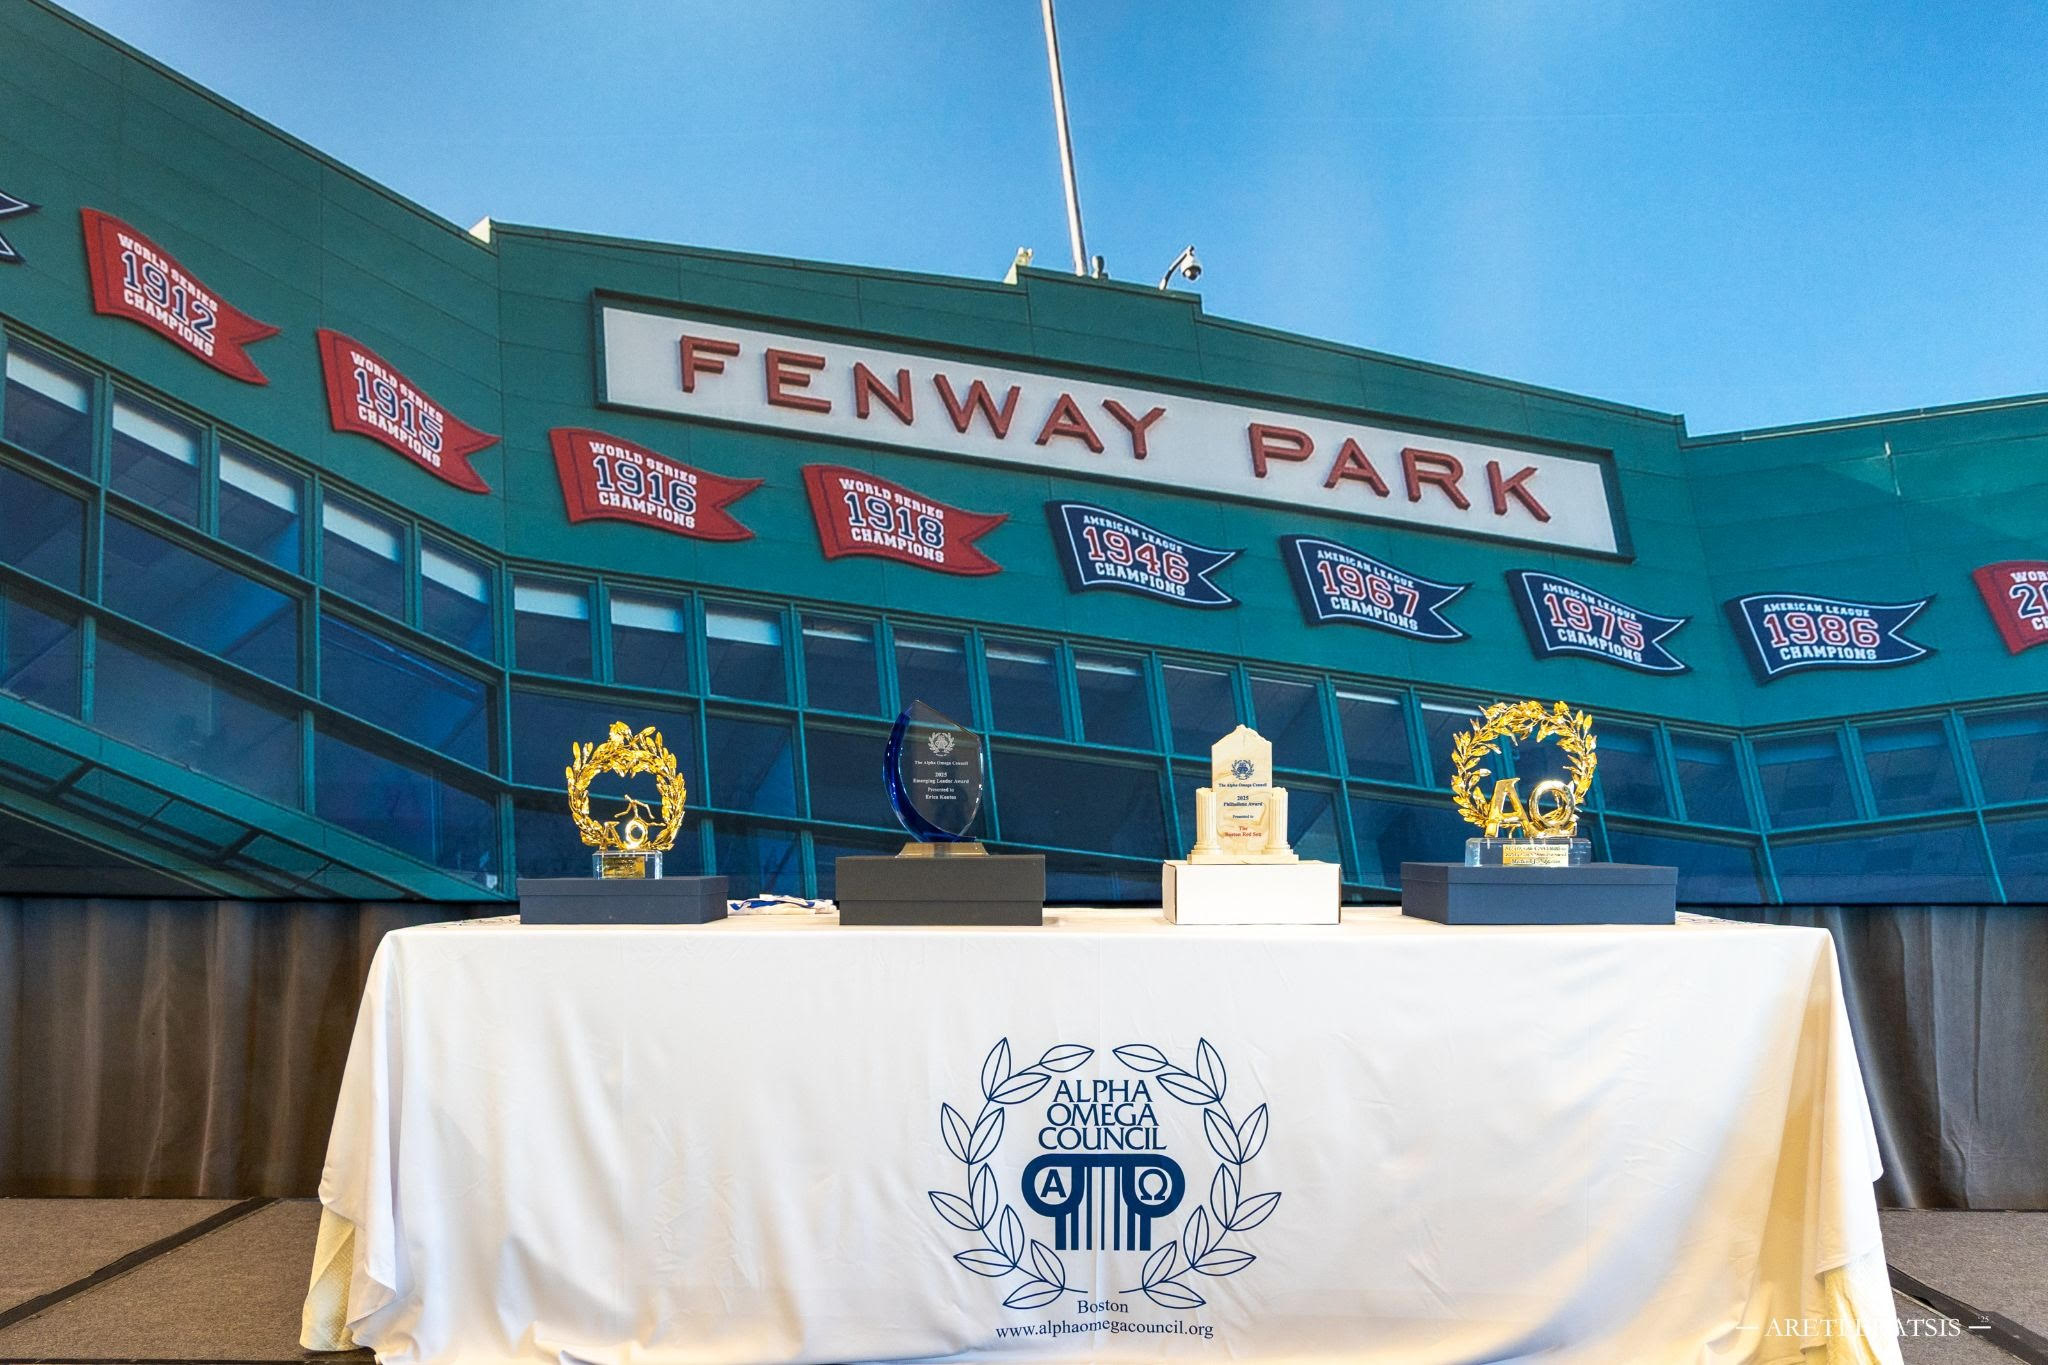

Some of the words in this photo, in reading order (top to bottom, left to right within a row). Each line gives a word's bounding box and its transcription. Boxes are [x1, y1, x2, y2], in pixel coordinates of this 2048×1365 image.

[117, 232, 169, 274] WORLD
[171, 268, 218, 312] SERIES
[121, 250, 216, 344] 1912
[124, 288, 213, 357] CHAMPIONS
[350, 351, 398, 389] WORLD
[399, 383, 443, 424] SERIES
[354, 367, 443, 453] 1915
[680, 335, 1166, 460] FENWAY
[1248, 422, 1551, 523] PARK
[358, 405, 441, 468] CHAMPIONS
[588, 441, 643, 465] WORLD
[646, 457, 697, 485] SERIES
[593, 455, 696, 515] 1916
[839, 478, 892, 500] WORLD
[894, 493, 944, 519] SERIES
[598, 491, 695, 529] CHAMPIONS
[844, 491, 944, 549] 1918
[851, 527, 944, 563] CHAMPIONS
[1083, 515, 1139, 537] AMERICAN
[1142, 532, 1183, 553] LEAGUE
[1083, 526, 1189, 585] 1946
[1317, 550, 1371, 572] AMERICAN
[1374, 567, 1414, 588] LEAGUE
[1095, 562, 1186, 597] CHAMPIONS
[1317, 561, 1419, 618] 1967
[1330, 597, 1418, 631] CHAMPIONS
[1543, 582, 1595, 604] AMERICAN
[1597, 599, 1637, 620] LEAGUE
[1763, 602, 1823, 614] AMERICAN
[1825, 605, 1870, 617] LEAGUE
[1544, 593, 1644, 651] 1975
[1763, 612, 1880, 648] 1986
[1557, 629, 1642, 663] CHAMPIONS
[1780, 645, 1877, 660] CHAMPIONS
[1053, 1079, 1153, 1103] ALPHA
[1046, 1103, 1160, 1127] OMEGA
[1038, 1127, 1167, 1150] COUNCIL
[1138, 1168, 1168, 1200] Ω
[1077, 1299, 1129, 1314] Boston
[995, 1317, 1214, 1339] www.alphaomegacouncil.org
